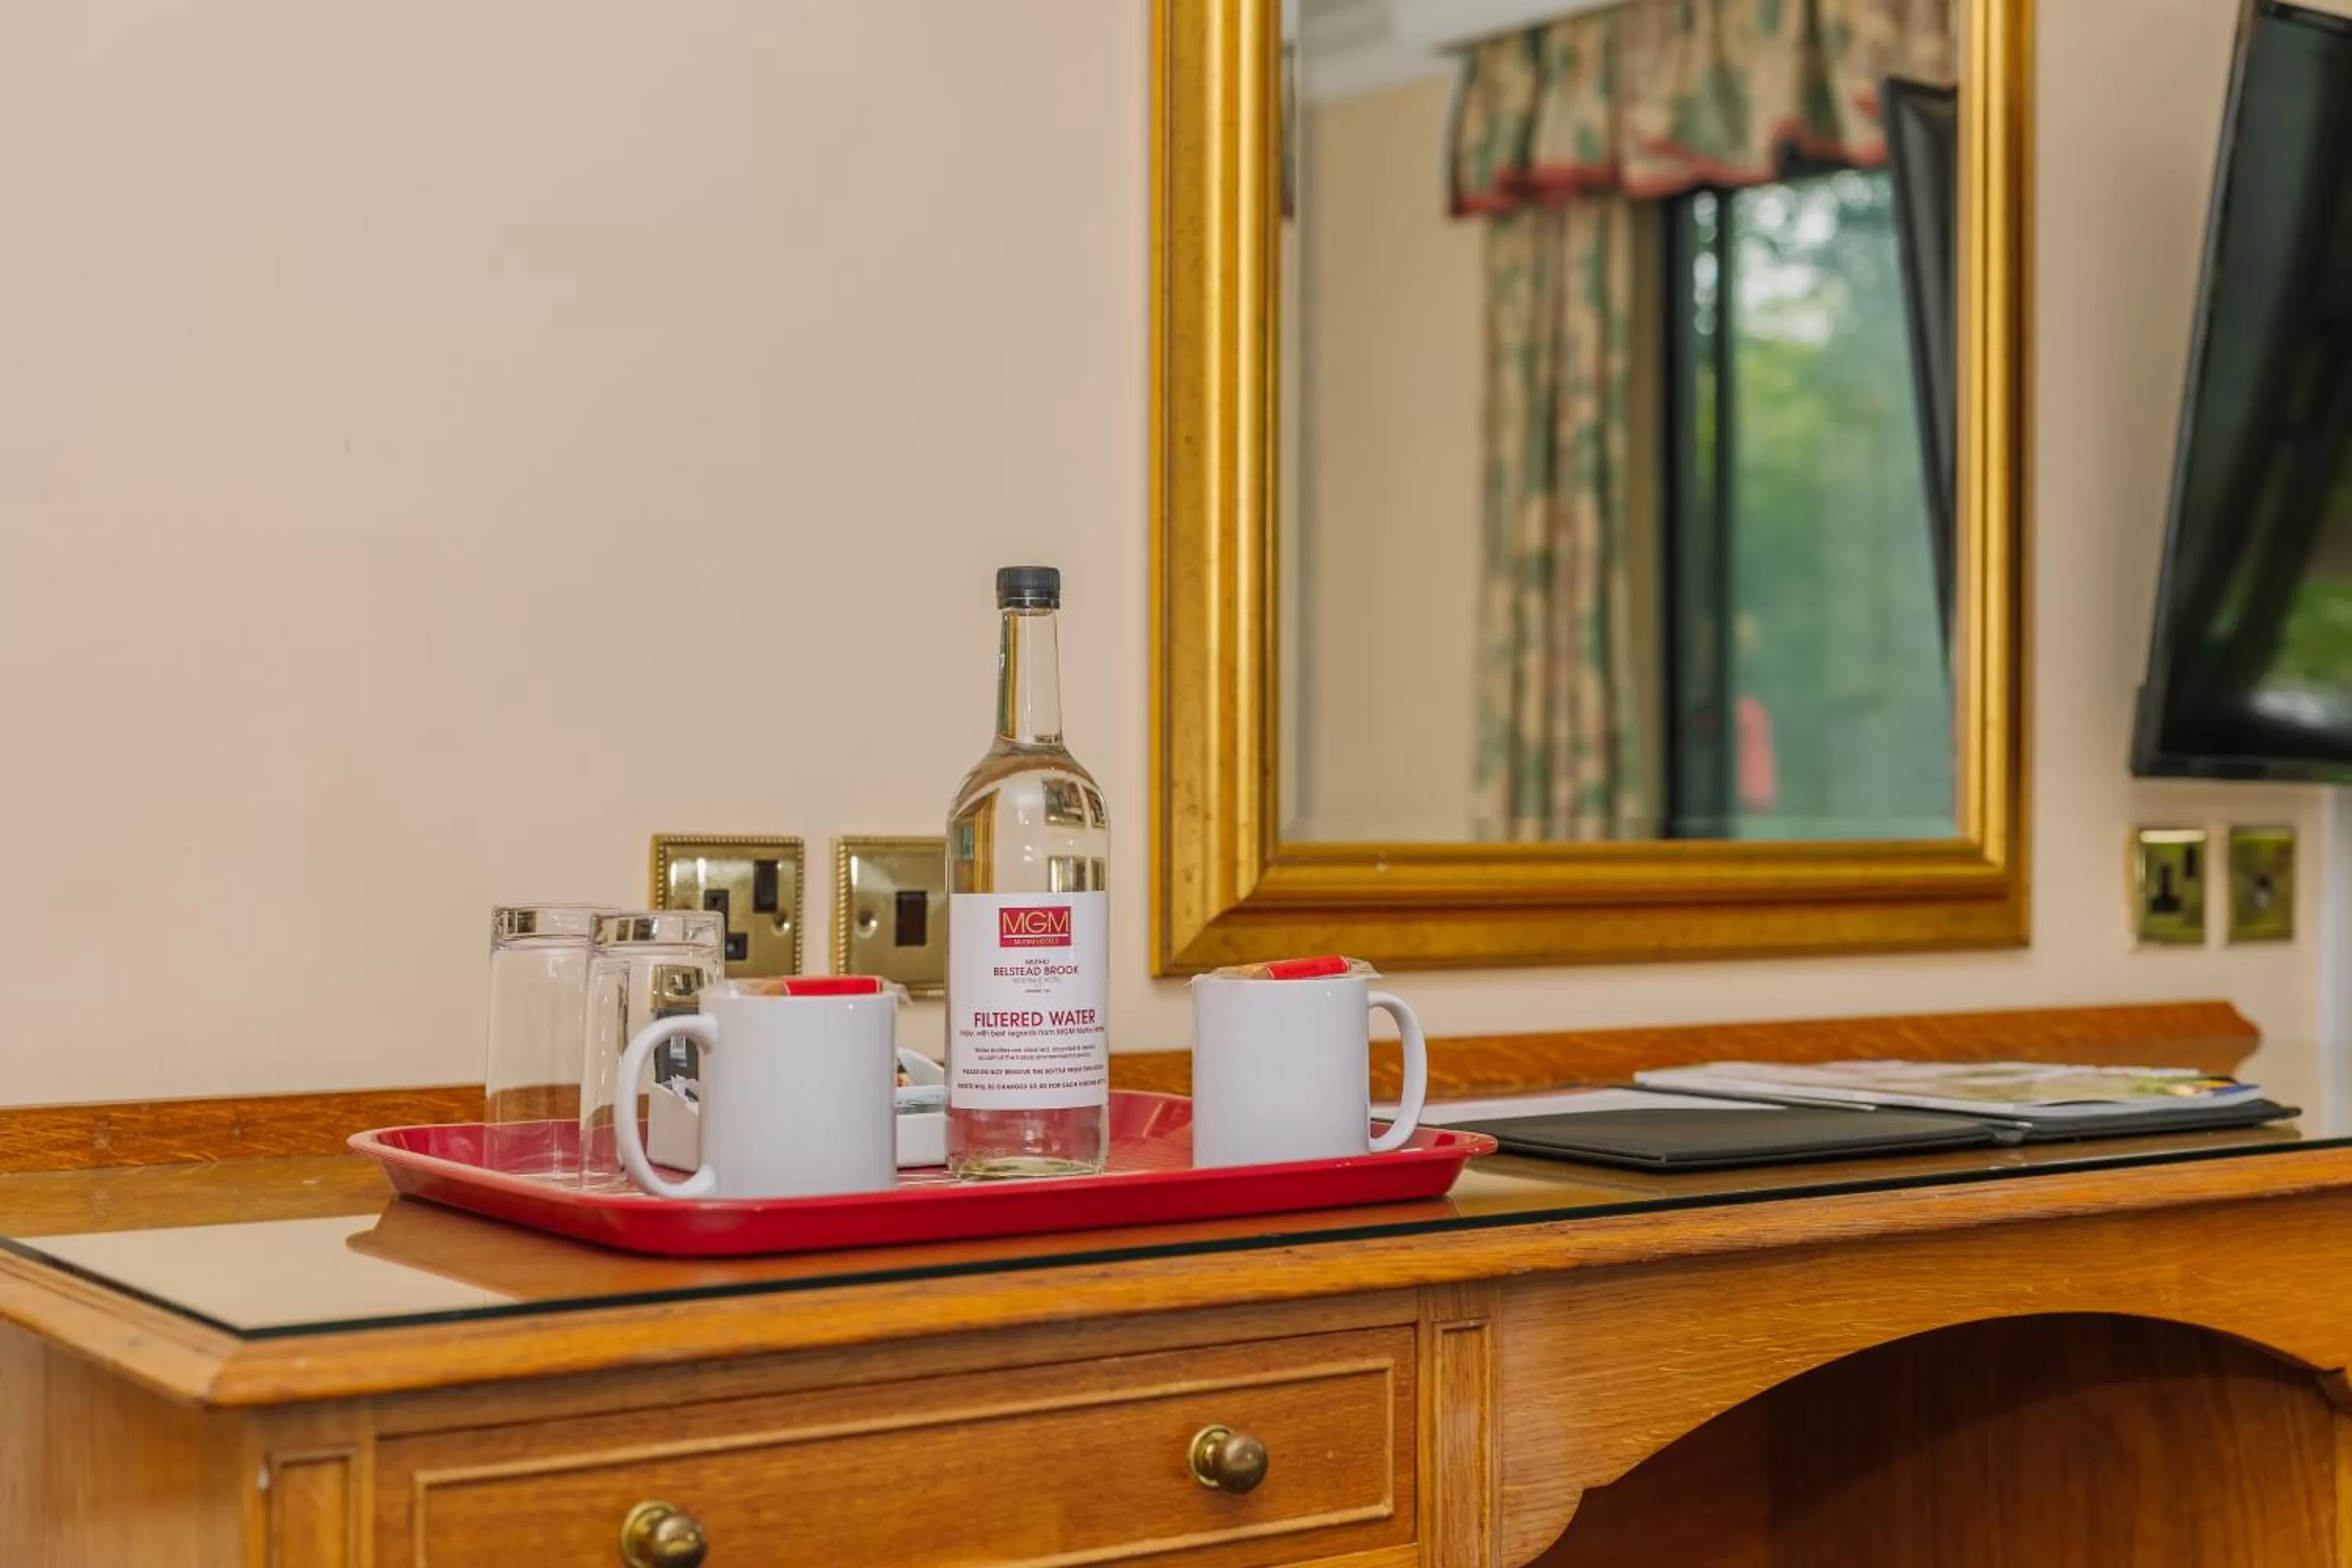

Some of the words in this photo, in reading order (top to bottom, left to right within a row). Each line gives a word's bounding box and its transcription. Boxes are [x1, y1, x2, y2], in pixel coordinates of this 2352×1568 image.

[1003, 911, 1069, 934] MGM
[993, 967, 1041, 976] BELSTEAD
[1044, 965, 1079, 975] BROOK
[974, 1011, 1044, 1028] FILTERED
[1049, 1009, 1095, 1026] WATER
